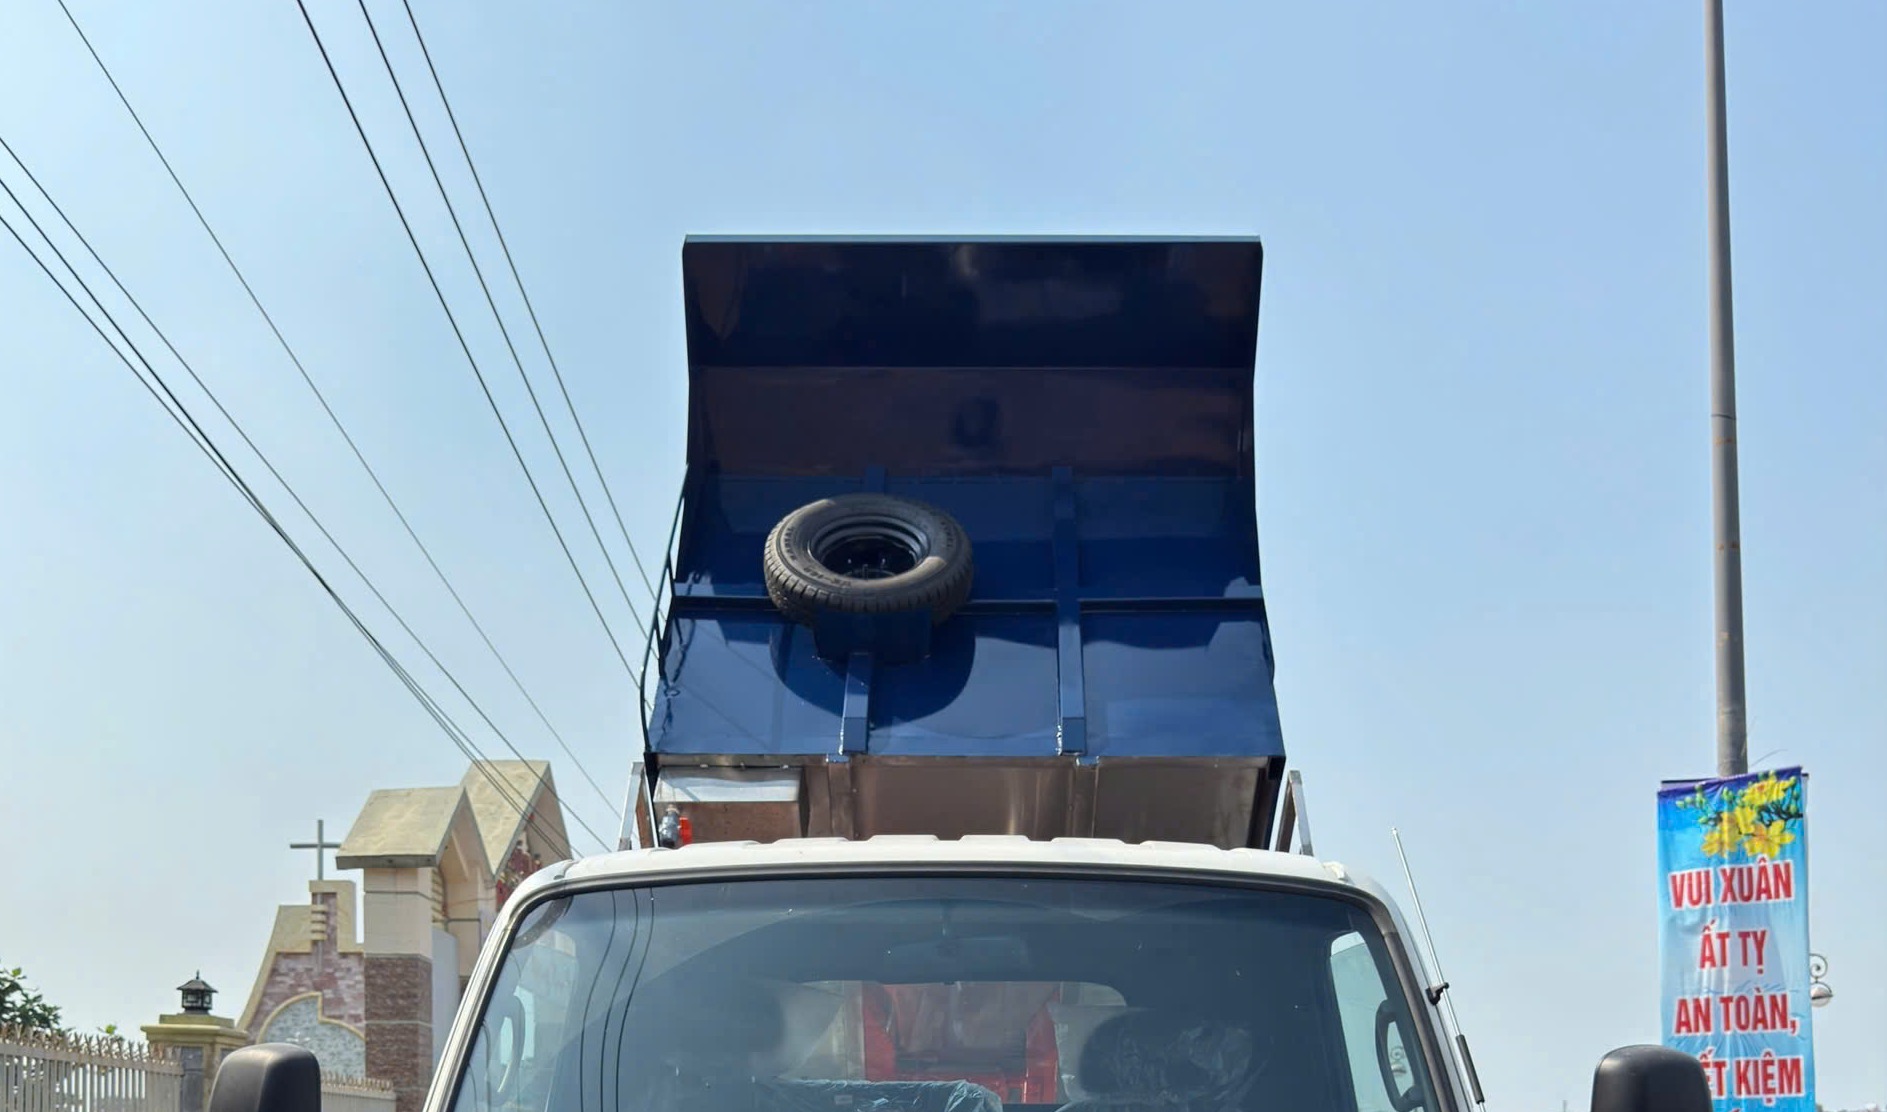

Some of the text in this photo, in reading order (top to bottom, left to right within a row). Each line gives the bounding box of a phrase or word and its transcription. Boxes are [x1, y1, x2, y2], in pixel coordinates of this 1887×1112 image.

[1670, 856, 1793, 909] VUI XUÂN
[1700, 918, 1768, 975] ẤT TỴ
[1674, 986, 1798, 1035] AN TOÀN,
[1735, 1050, 1803, 1104] KIỆM
